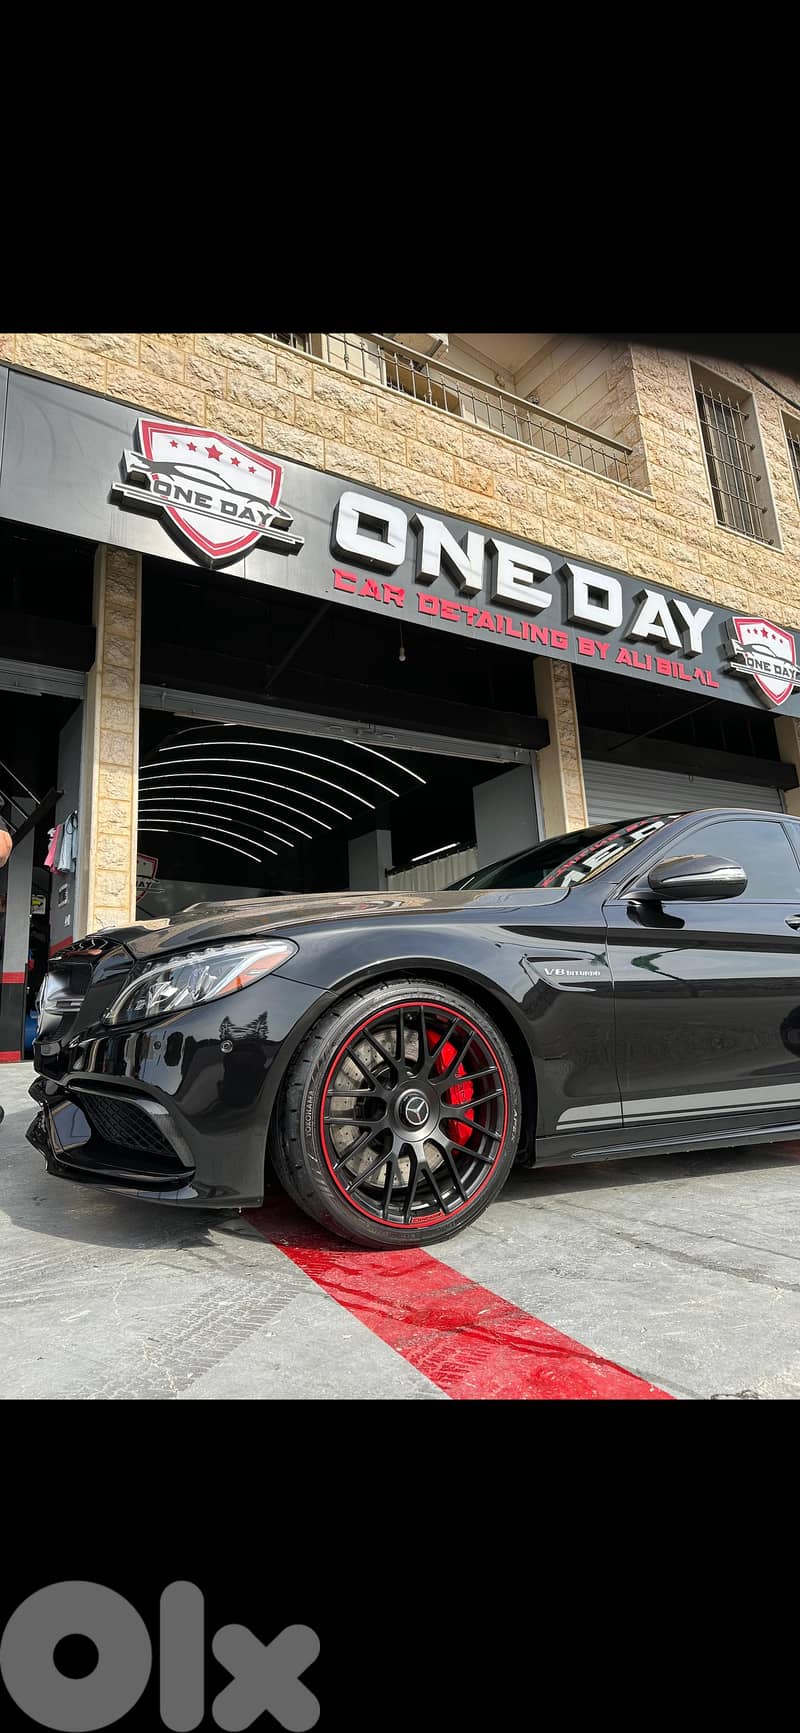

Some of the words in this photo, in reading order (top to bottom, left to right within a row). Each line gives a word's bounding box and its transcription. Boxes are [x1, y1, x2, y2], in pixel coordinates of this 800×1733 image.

[153, 479, 213, 510] ONE
[220, 499, 272, 526] DAY
[332, 568, 406, 608] CAR
[417, 592, 569, 650] DETAILING
[575, 637, 609, 661] BY
[614, 647, 652, 672] ALI
[746, 657, 771, 672] ONE
[774, 664, 795, 679] DAY
[544, 968, 565, 976] V8
[304, 1090, 314, 1137] YOKOHAMA
